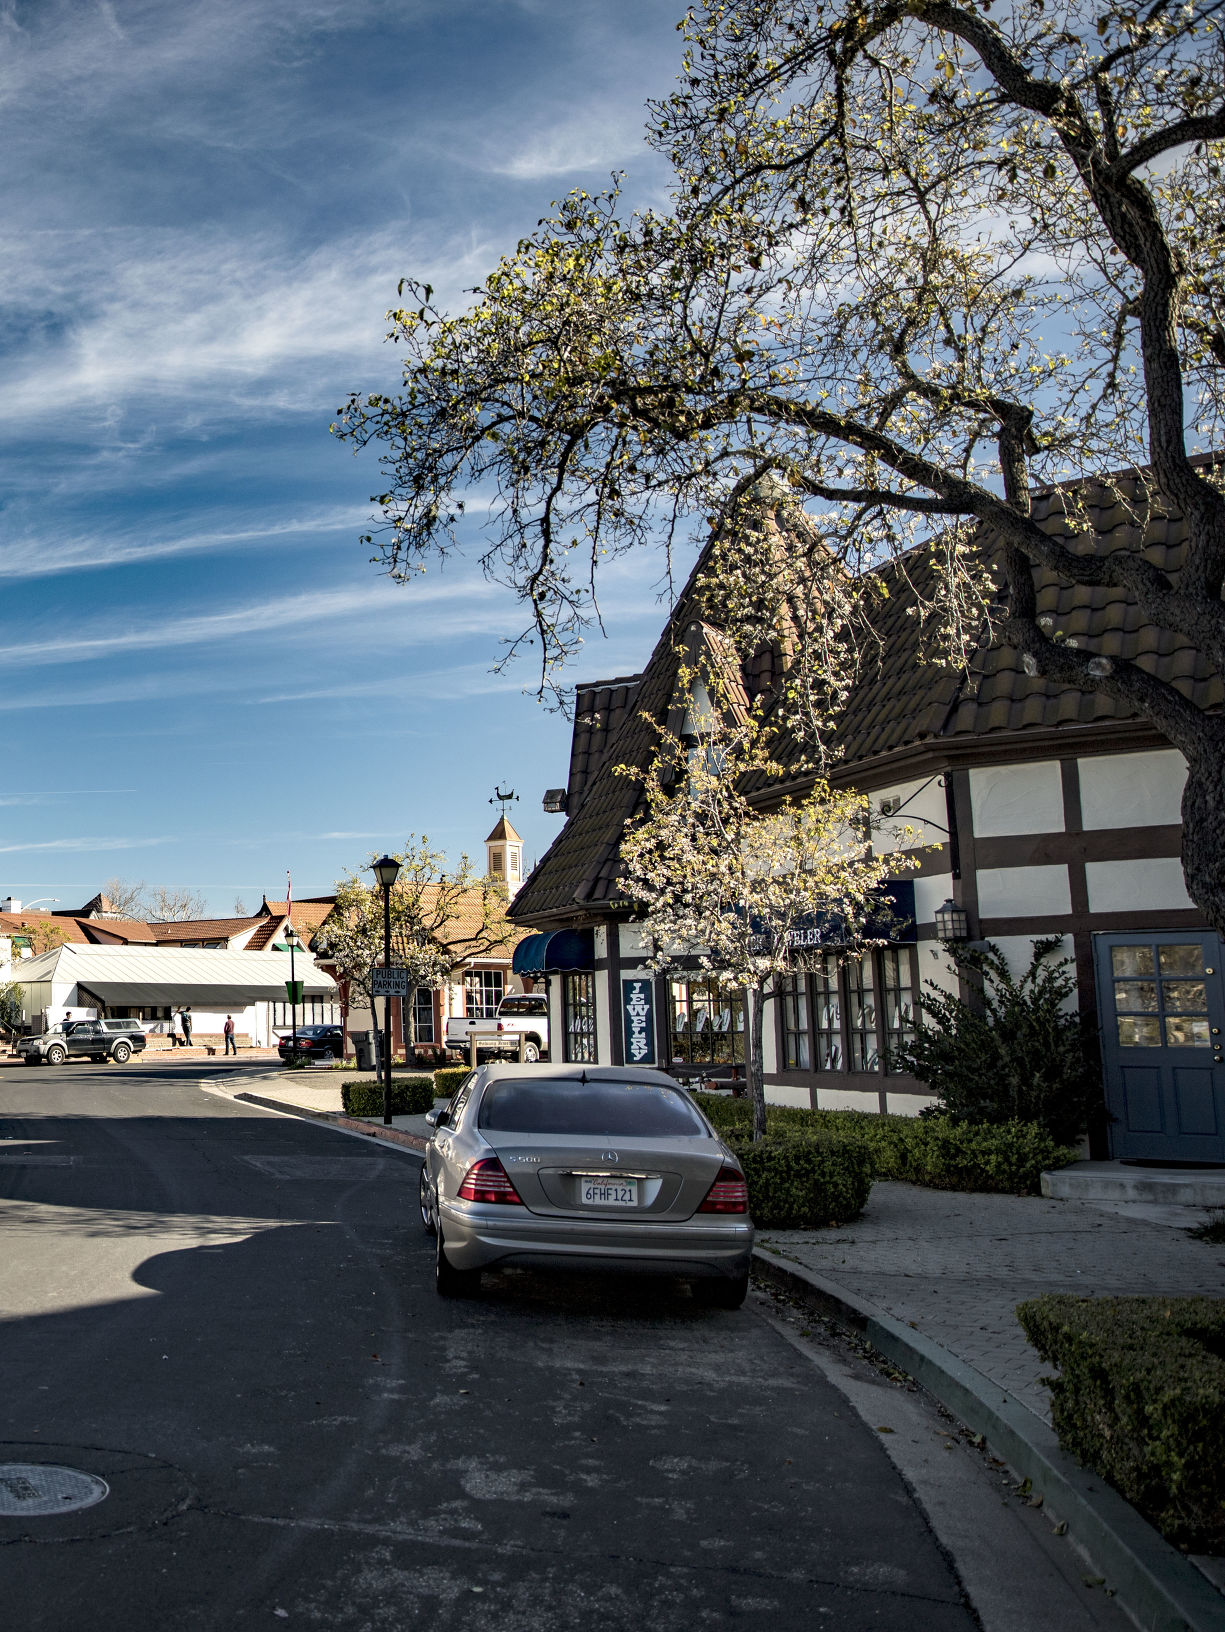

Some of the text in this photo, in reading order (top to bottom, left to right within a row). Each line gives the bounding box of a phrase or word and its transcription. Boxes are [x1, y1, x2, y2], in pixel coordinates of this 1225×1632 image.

[376, 970, 405, 980] PUBLIC
[373, 980, 406, 990] PARKING
[626, 982, 650, 1061] JEWELRY
[592, 1179, 626, 1188] California
[585, 1187, 634, 1202] 6FHF121
